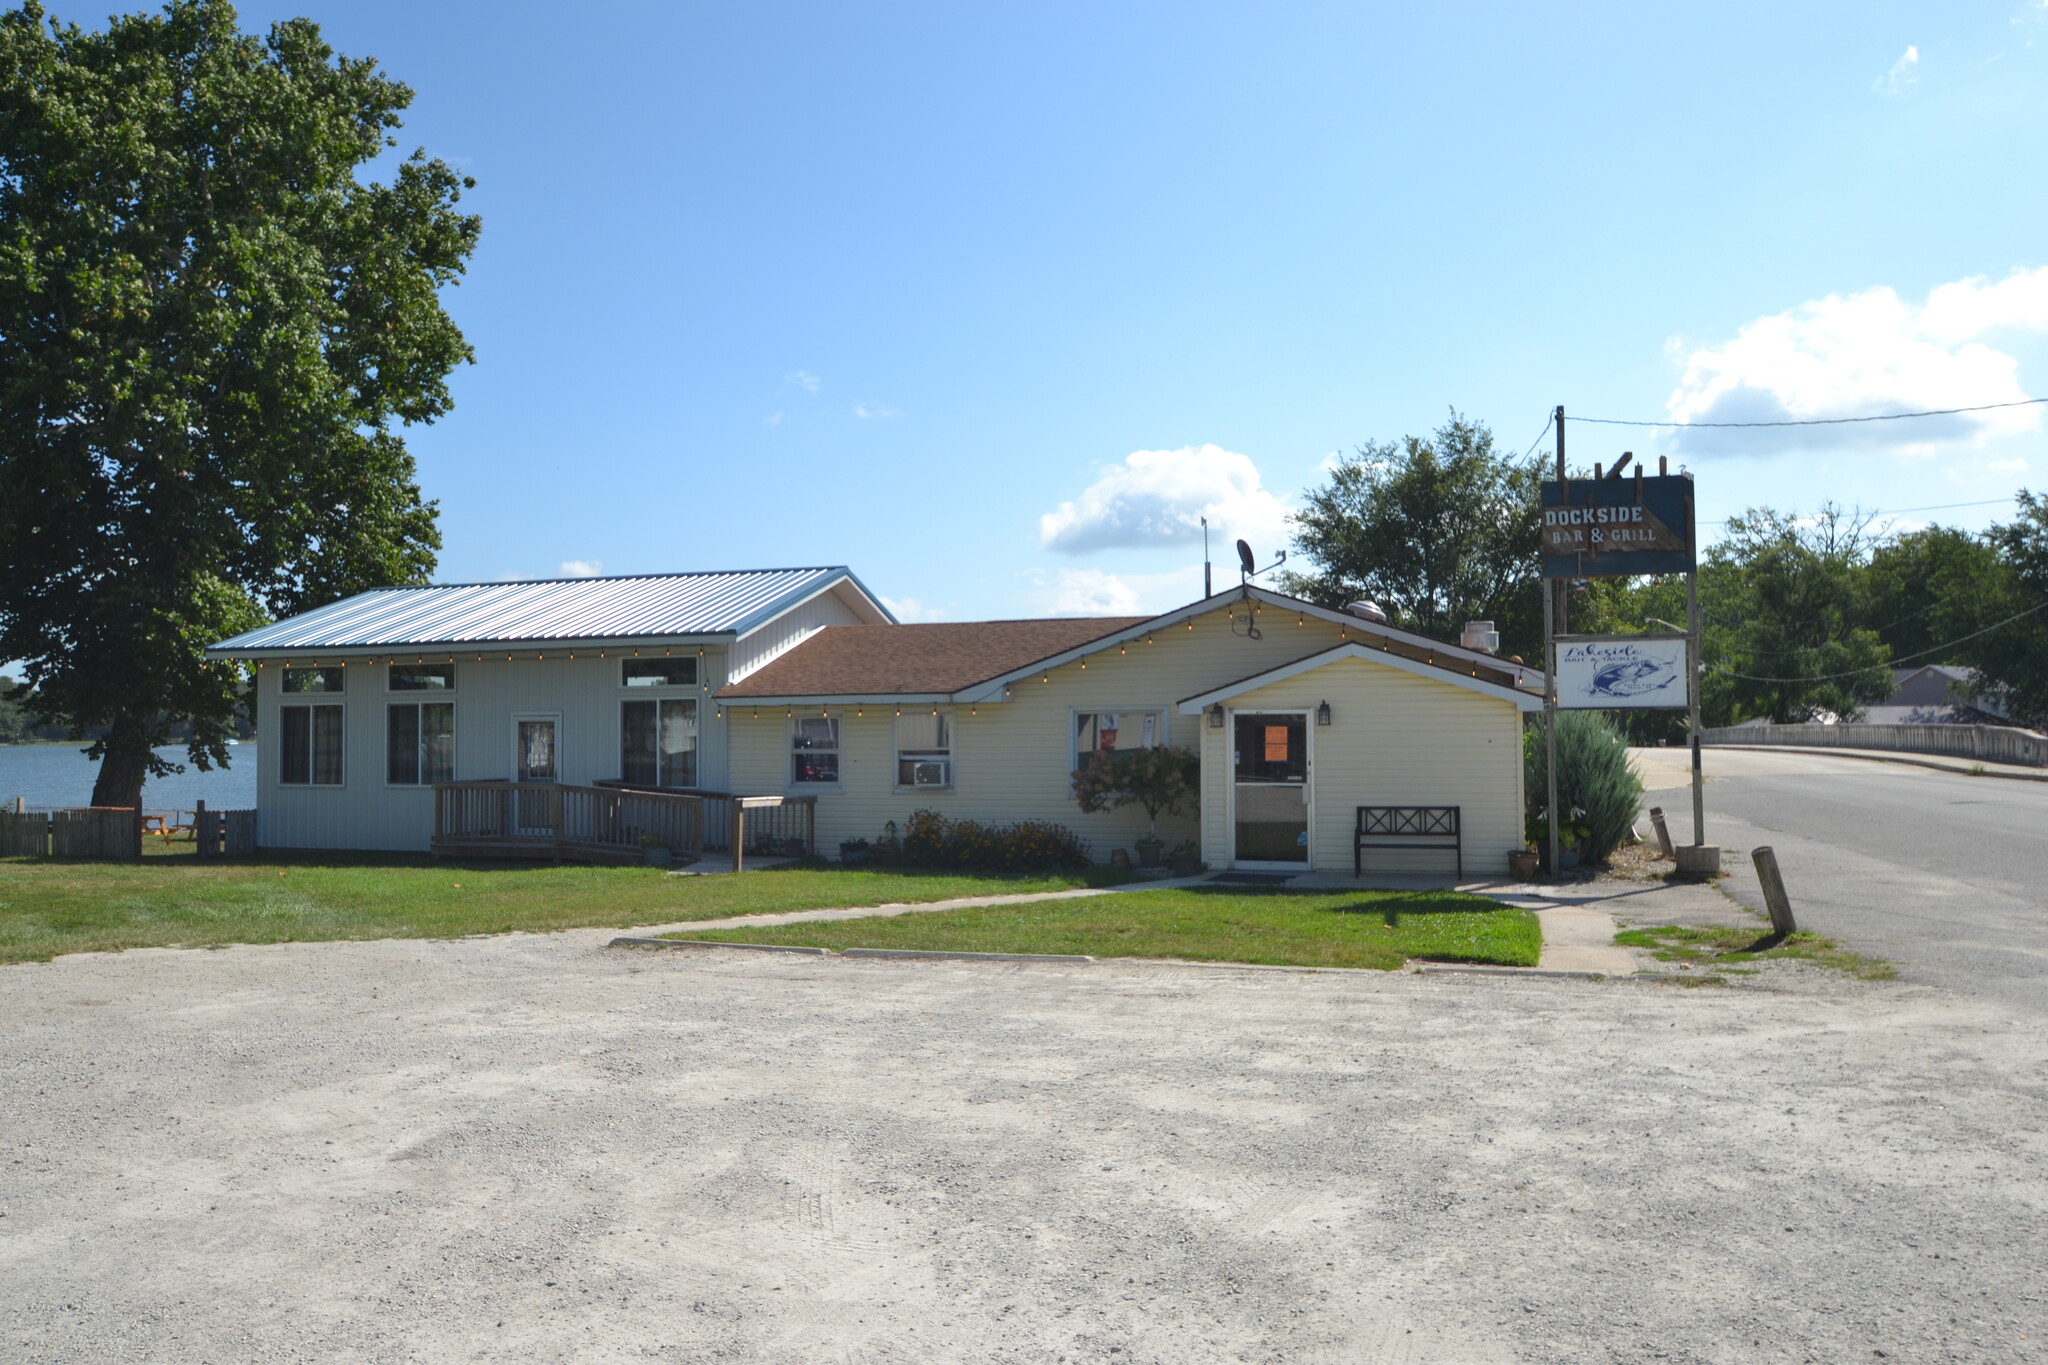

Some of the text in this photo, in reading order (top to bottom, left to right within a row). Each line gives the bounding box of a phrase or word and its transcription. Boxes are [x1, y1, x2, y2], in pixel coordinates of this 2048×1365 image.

[1545, 507, 1642, 526] DOCKSIDE
[1552, 527, 1656, 544] BAR & GRILL
[1565, 644, 1641, 656] Lakeside
